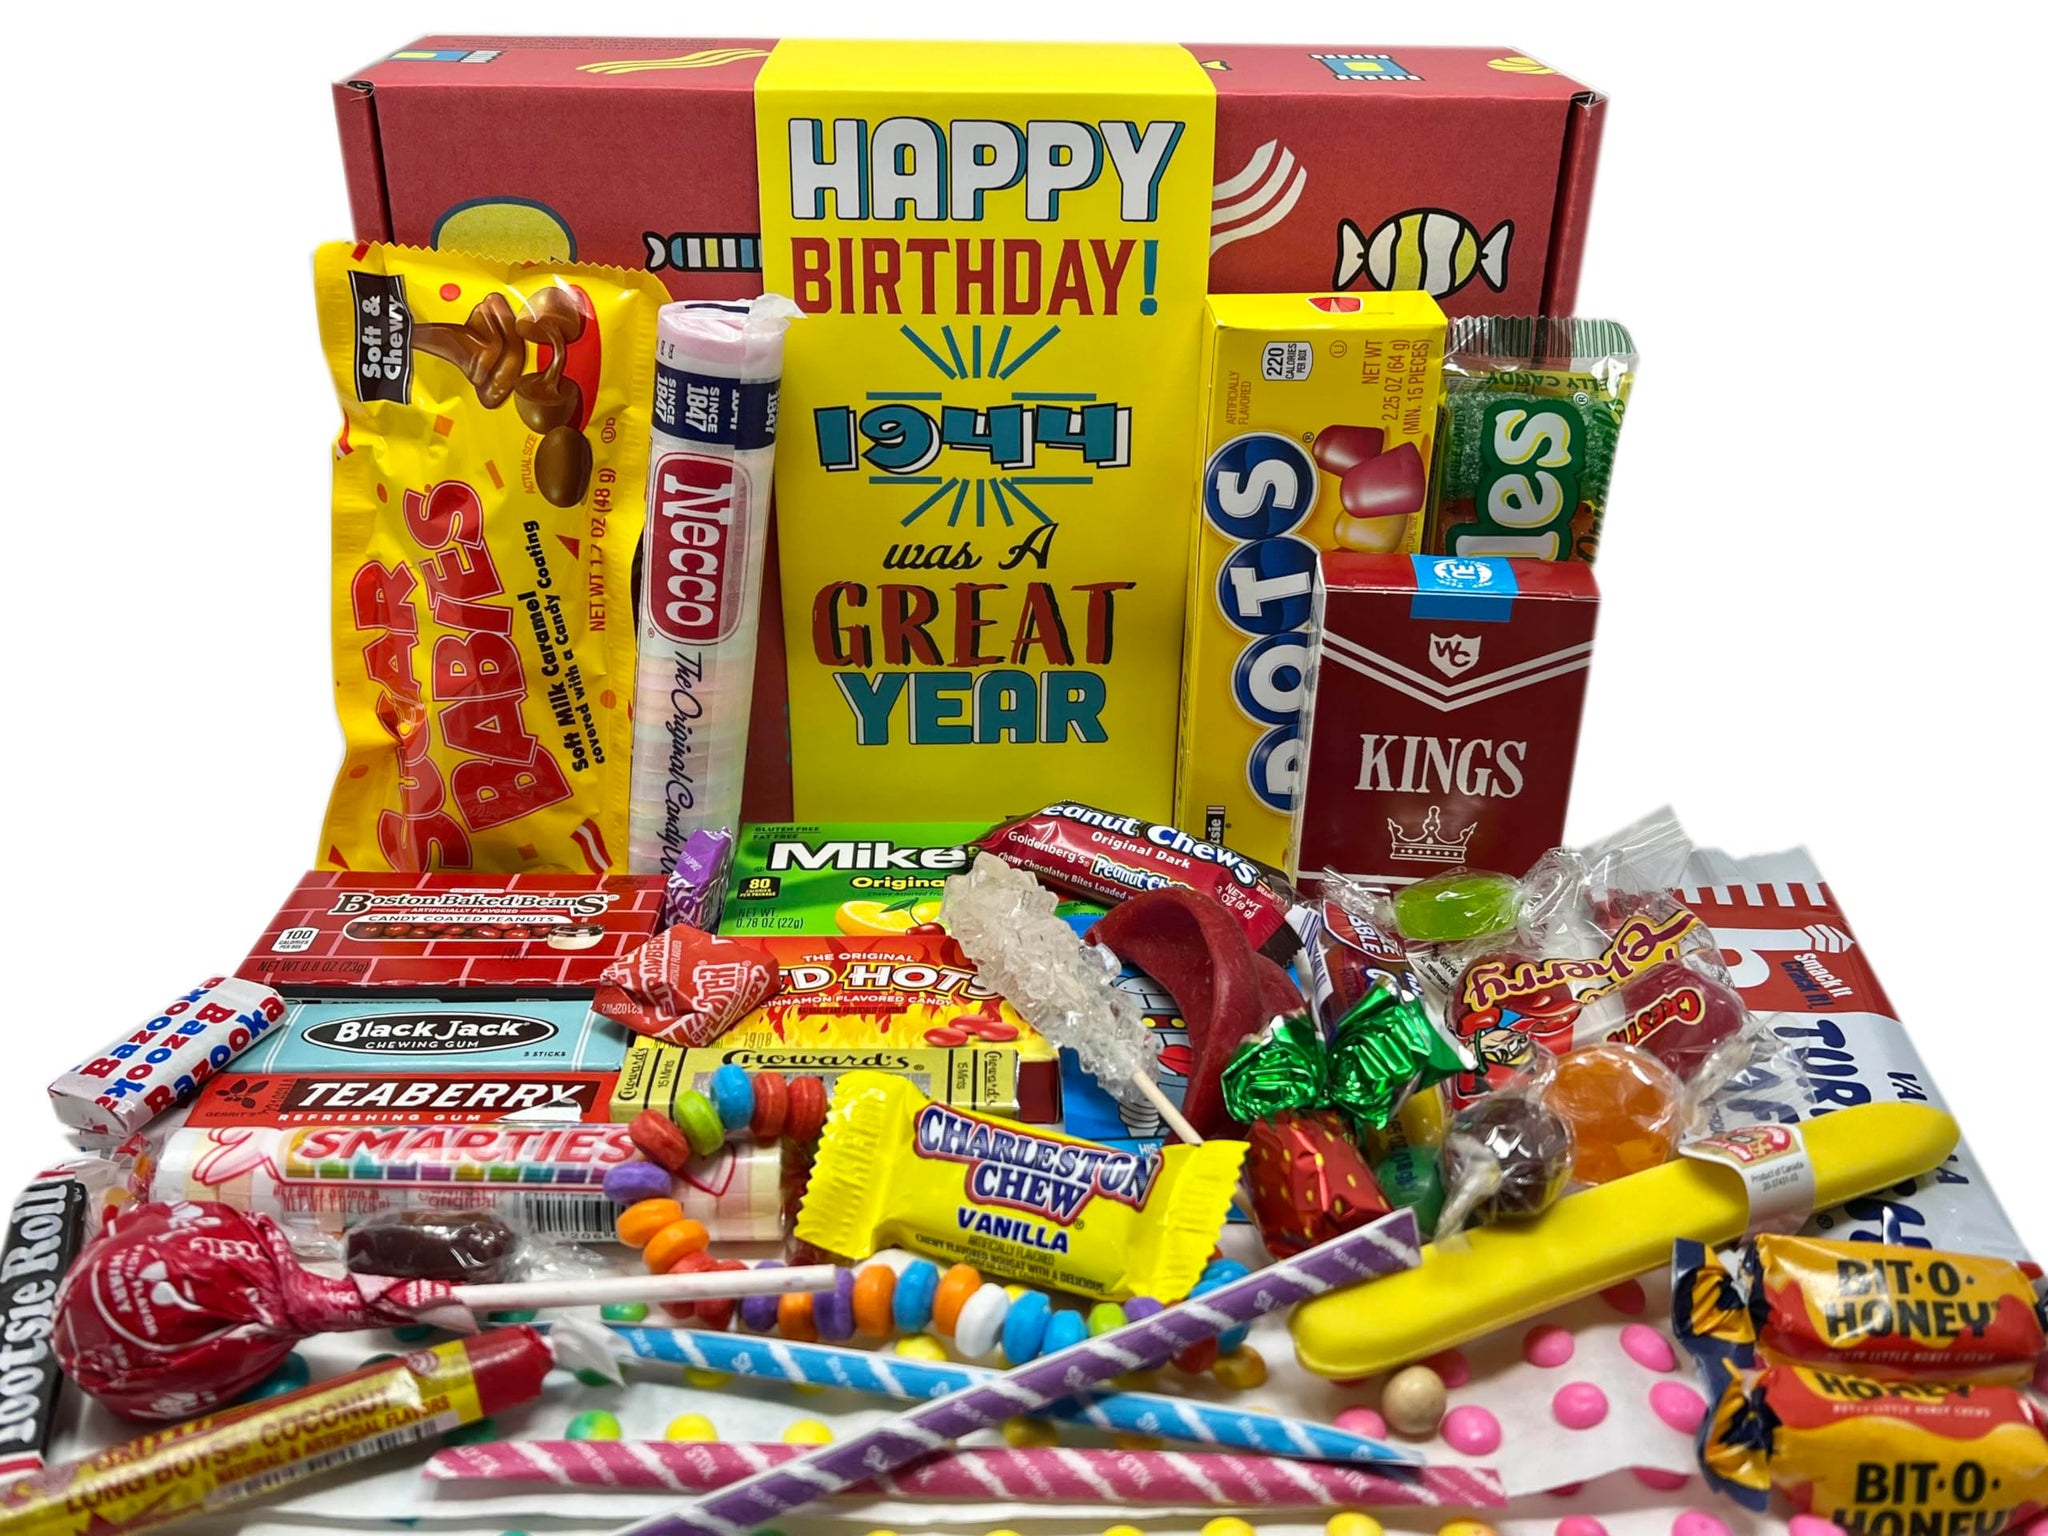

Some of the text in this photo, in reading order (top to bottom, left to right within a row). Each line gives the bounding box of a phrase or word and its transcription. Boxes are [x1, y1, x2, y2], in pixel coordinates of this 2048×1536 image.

[788, 117, 1185, 221] HAPPY
[790, 237, 1158, 316] BIRTHDAY!
[362, 295, 382, 379] Soft &
[382, 294, 405, 381] Chewy
[1266, 347, 1284, 376] 220
[1285, 343, 1297, 379] CALORIES
[1296, 362, 1307, 374] PER
[1361, 339, 1383, 385] NET WT
[1381, 339, 1411, 421] 2.25 OZ (64 g)
[655, 372, 669, 423] 1847
[666, 378, 677, 426] SINCE
[1225, 370, 1240, 425] ARTIFICIALLY
[1238, 381, 1251, 425] FLAVORED
[1402, 339, 1434, 435] (MIN. 15 PIECES)
[685, 383, 709, 433] 1847
[707, 386, 720, 434] SINCE
[814, 402, 1132, 475] 1944
[524, 433, 538, 495] ACTUAL SIZE
[598, 467, 617, 484] g)
[593, 487, 612, 513] (48
[591, 517, 606, 539] OZ
[882, 523, 1059, 570] was A
[662, 473, 735, 627] Necco
[589, 573, 604, 596] WT
[590, 602, 606, 631] NET
[812, 580, 1136, 668] GREAT
[403, 480, 573, 832] BABIES
[523, 519, 605, 764] covered with a candy coating
[517, 590, 589, 772] Soft Milk Caramel
[674, 650, 703, 689] The
[833, 670, 1108, 745] YEAR
[665, 688, 703, 784] Original
[1354, 733, 1527, 798] KINGS
[656, 779, 694, 847] Candy
[770, 842, 967, 870] Mike
[1008, 831, 1086, 864] Goldenberg's
[1041, 805, 1260, 887] eanut Chews
[1090, 831, 1190, 869] Original Dark
[749, 878, 771, 889] 80
[851, 876, 946, 889] Origina
[998, 852, 1023, 866] Chewy
[1024, 859, 1070, 881] Chocolatey
[1070, 874, 1093, 889] Bites
[1094, 881, 1127, 899] Loaded
[1092, 857, 1147, 888] Peanut
[327, 893, 438, 915] Boston
[439, 894, 517, 908] Baked
[738, 907, 758, 918] NET
[1220, 895, 1236, 907] OZ
[1225, 882, 1263, 912] NET WT
[285, 930, 313, 940] 100
[424, 915, 483, 923] COATED
[735, 917, 804, 929] 0.78 OZ (22g)
[257, 960, 369, 974] NET WT 0.8 OZ (23g)
[778, 964, 832, 990] ED
[803, 953, 914, 963] THE ORIGINAL
[1472, 914, 1697, 1009] Cherry
[1780, 960, 1822, 993] Crack
[1793, 952, 1854, 998] Smack It
[760, 995, 953, 1008] CINNAMON FLAVORED CANDY
[80, 977, 226, 1080] Bazooka
[333, 1020, 521, 1043] Black Jack
[364, 1040, 480, 1049] CHEWING GUM
[94, 1002, 236, 1114] Bazooka
[143, 996, 285, 1116] Bazooka
[658, 1058, 676, 1088] 15 Mints
[298, 1082, 588, 1109] TEABERRY
[277, 1114, 481, 1123] REFRESHING GUM
[301, 1127, 635, 1163] SMARTIES
[919, 1105, 1159, 1204] CHARLESTON
[974, 1163, 1088, 1219] CHEW
[1751, 1169, 1775, 1184] Product
[1780, 1161, 1805, 1176] Canada
[0, 1184, 67, 1282] Roll
[957, 1207, 1069, 1254] VANILLA
[946, 1240, 989, 1261] FLAVORED
[989, 1253, 1026, 1272] NOUGAT
[1028, 1261, 1051, 1278] WITH
[967, 1234, 1055, 1267] ARTIFICIALLY FLAVORED
[1824, 1298, 1993, 1340] HONEY
[66, 1475, 146, 1514] LONG
[259, 1386, 391, 1448] COCONUT
[684, 1445, 719, 1481] STIX
[1116, 1454, 1155, 1490] STIX
[1830, 1508, 2010, 1536] HONEY
